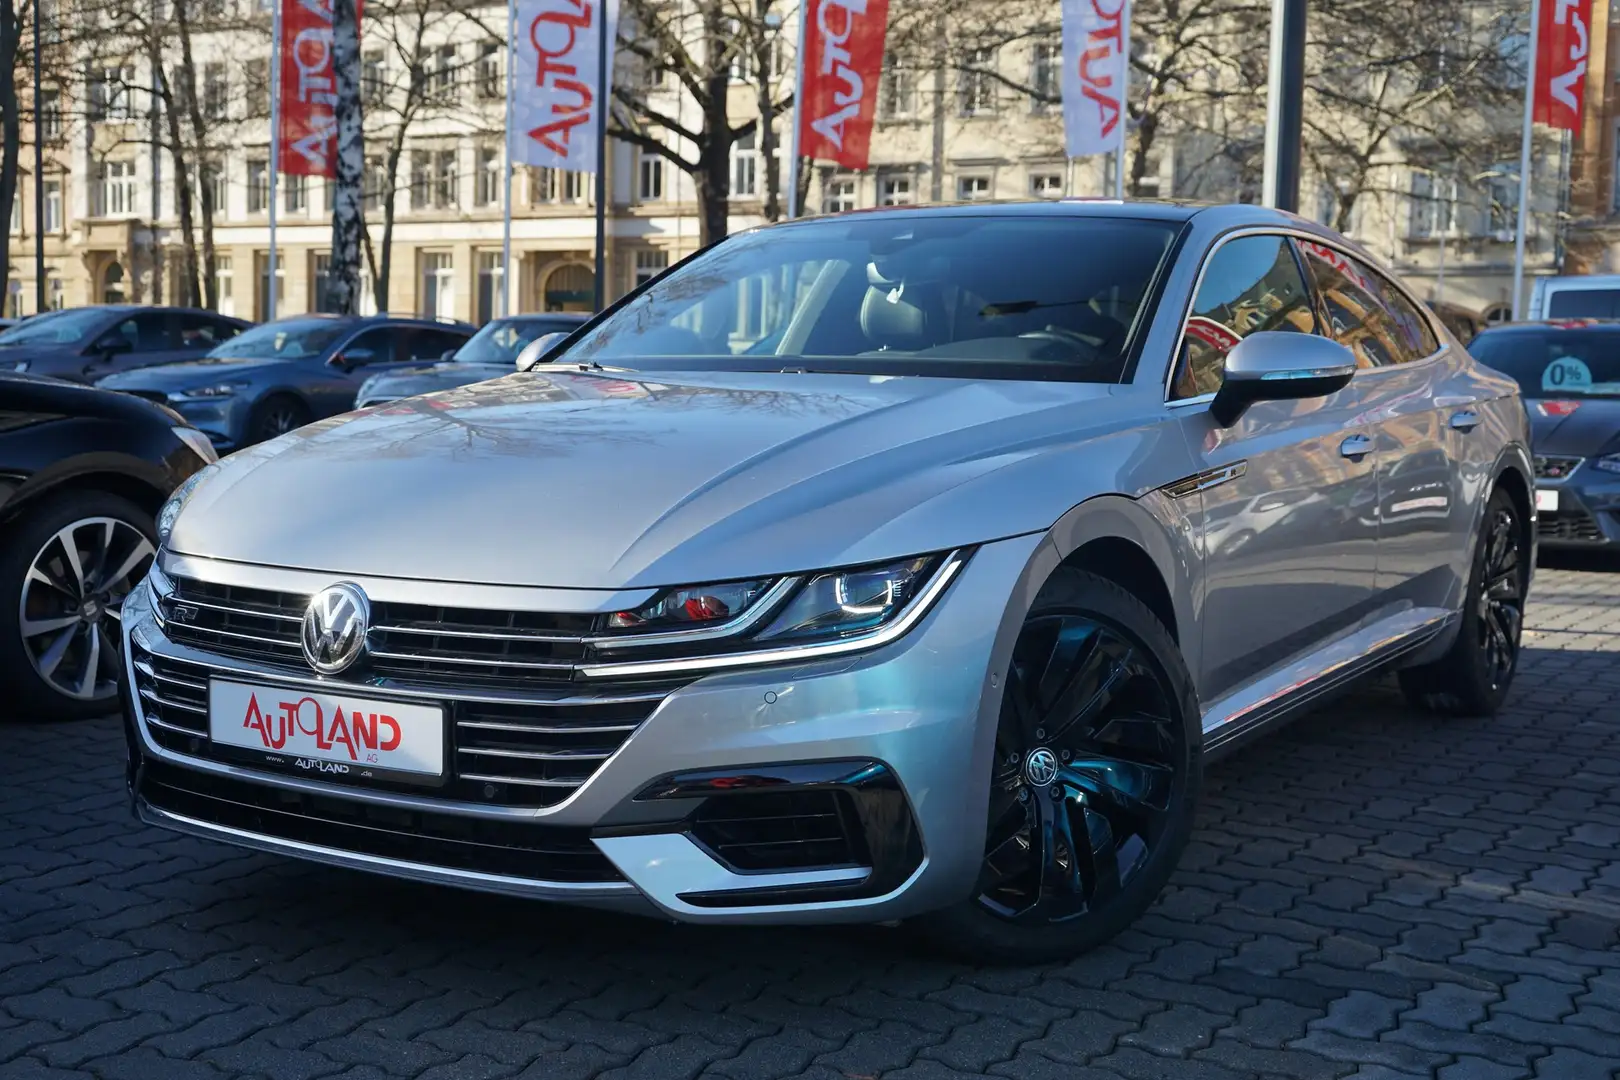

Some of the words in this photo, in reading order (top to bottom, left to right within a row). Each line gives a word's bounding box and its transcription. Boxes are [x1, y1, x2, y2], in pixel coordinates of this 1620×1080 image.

[528, 0, 592, 158] AUTOL
[1550, 363, 1582, 386] 0%
[243, 691, 403, 760] AUTOLAND
[265, 755, 285, 763] www.
[366, 753, 379, 764] AG
